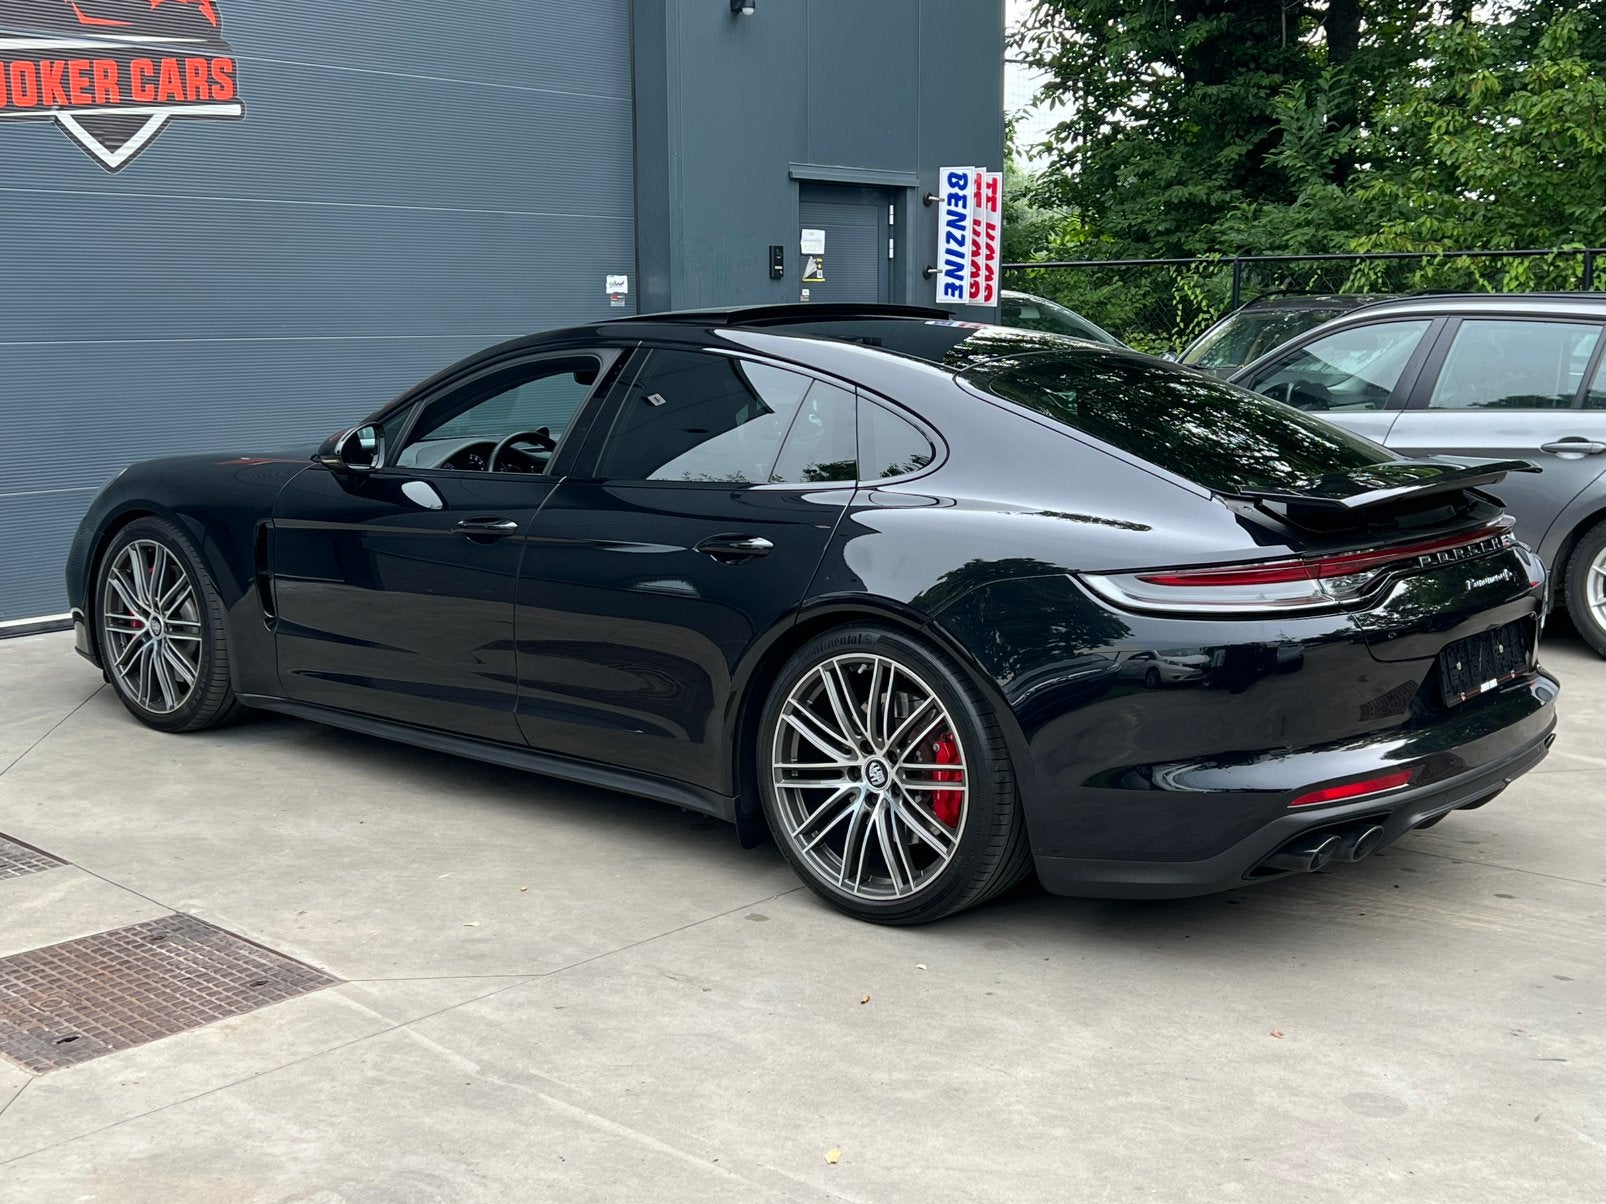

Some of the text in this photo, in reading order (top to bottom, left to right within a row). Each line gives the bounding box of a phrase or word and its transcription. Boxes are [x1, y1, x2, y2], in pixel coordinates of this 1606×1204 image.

[0, 57, 235, 108] OKER CARS
[944, 172, 969, 299] BENZINE
